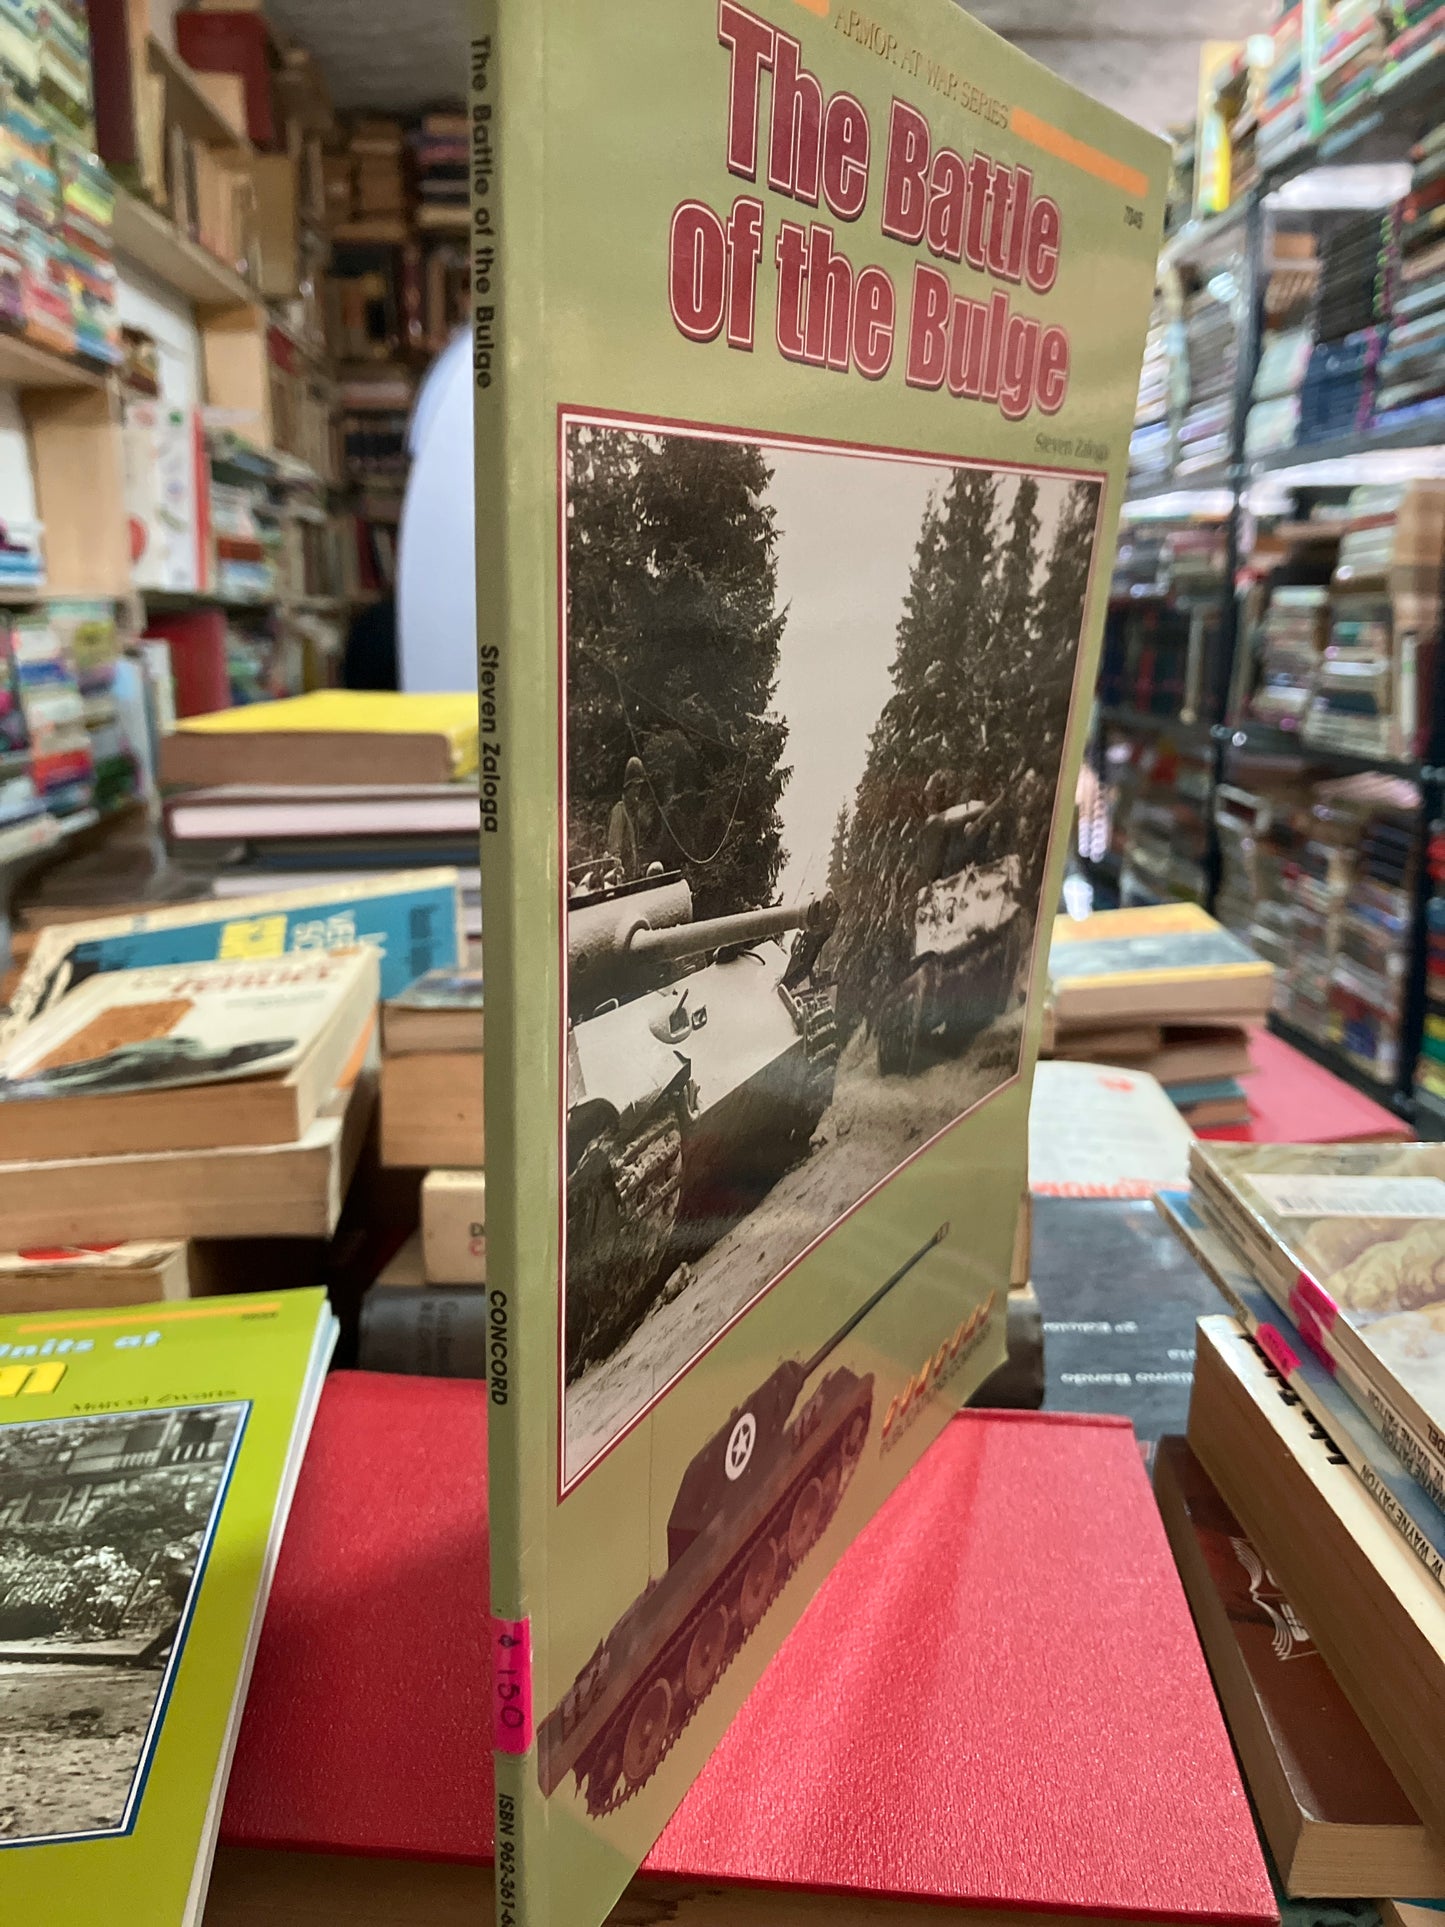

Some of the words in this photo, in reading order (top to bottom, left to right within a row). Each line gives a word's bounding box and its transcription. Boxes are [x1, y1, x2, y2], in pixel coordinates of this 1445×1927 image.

[471, 34, 491, 92] The
[834, 7, 898, 64] ARMOR
[901, 50, 922, 77] AT
[926, 60, 959, 101] WAR
[960, 81, 1009, 130] SERIES
[472, 104, 493, 196] Battle
[717, 0, 870, 222] The
[882, 96, 1061, 295] Battle
[474, 207, 494, 236] of
[475, 247, 494, 295] the
[668, 195, 764, 352] Of
[775, 219, 896, 381] the
[906, 260, 1070, 421] Bulge
[474, 306, 495, 389] Bulge
[481, 644, 500, 733] Steven
[480, 741, 500, 833] Zaloga
[114, 1330, 162, 1348] at
[490, 1290, 508, 1406] CONCORD
[1360, 1464, 1396, 1514] PATTON
[1393, 1507, 1430, 1558] WAYNE
[1431, 1554, 1444, 1578] W.
[499, 1793, 515, 1836] ISBN
[500, 1841, 516, 1927] 962-361-6
